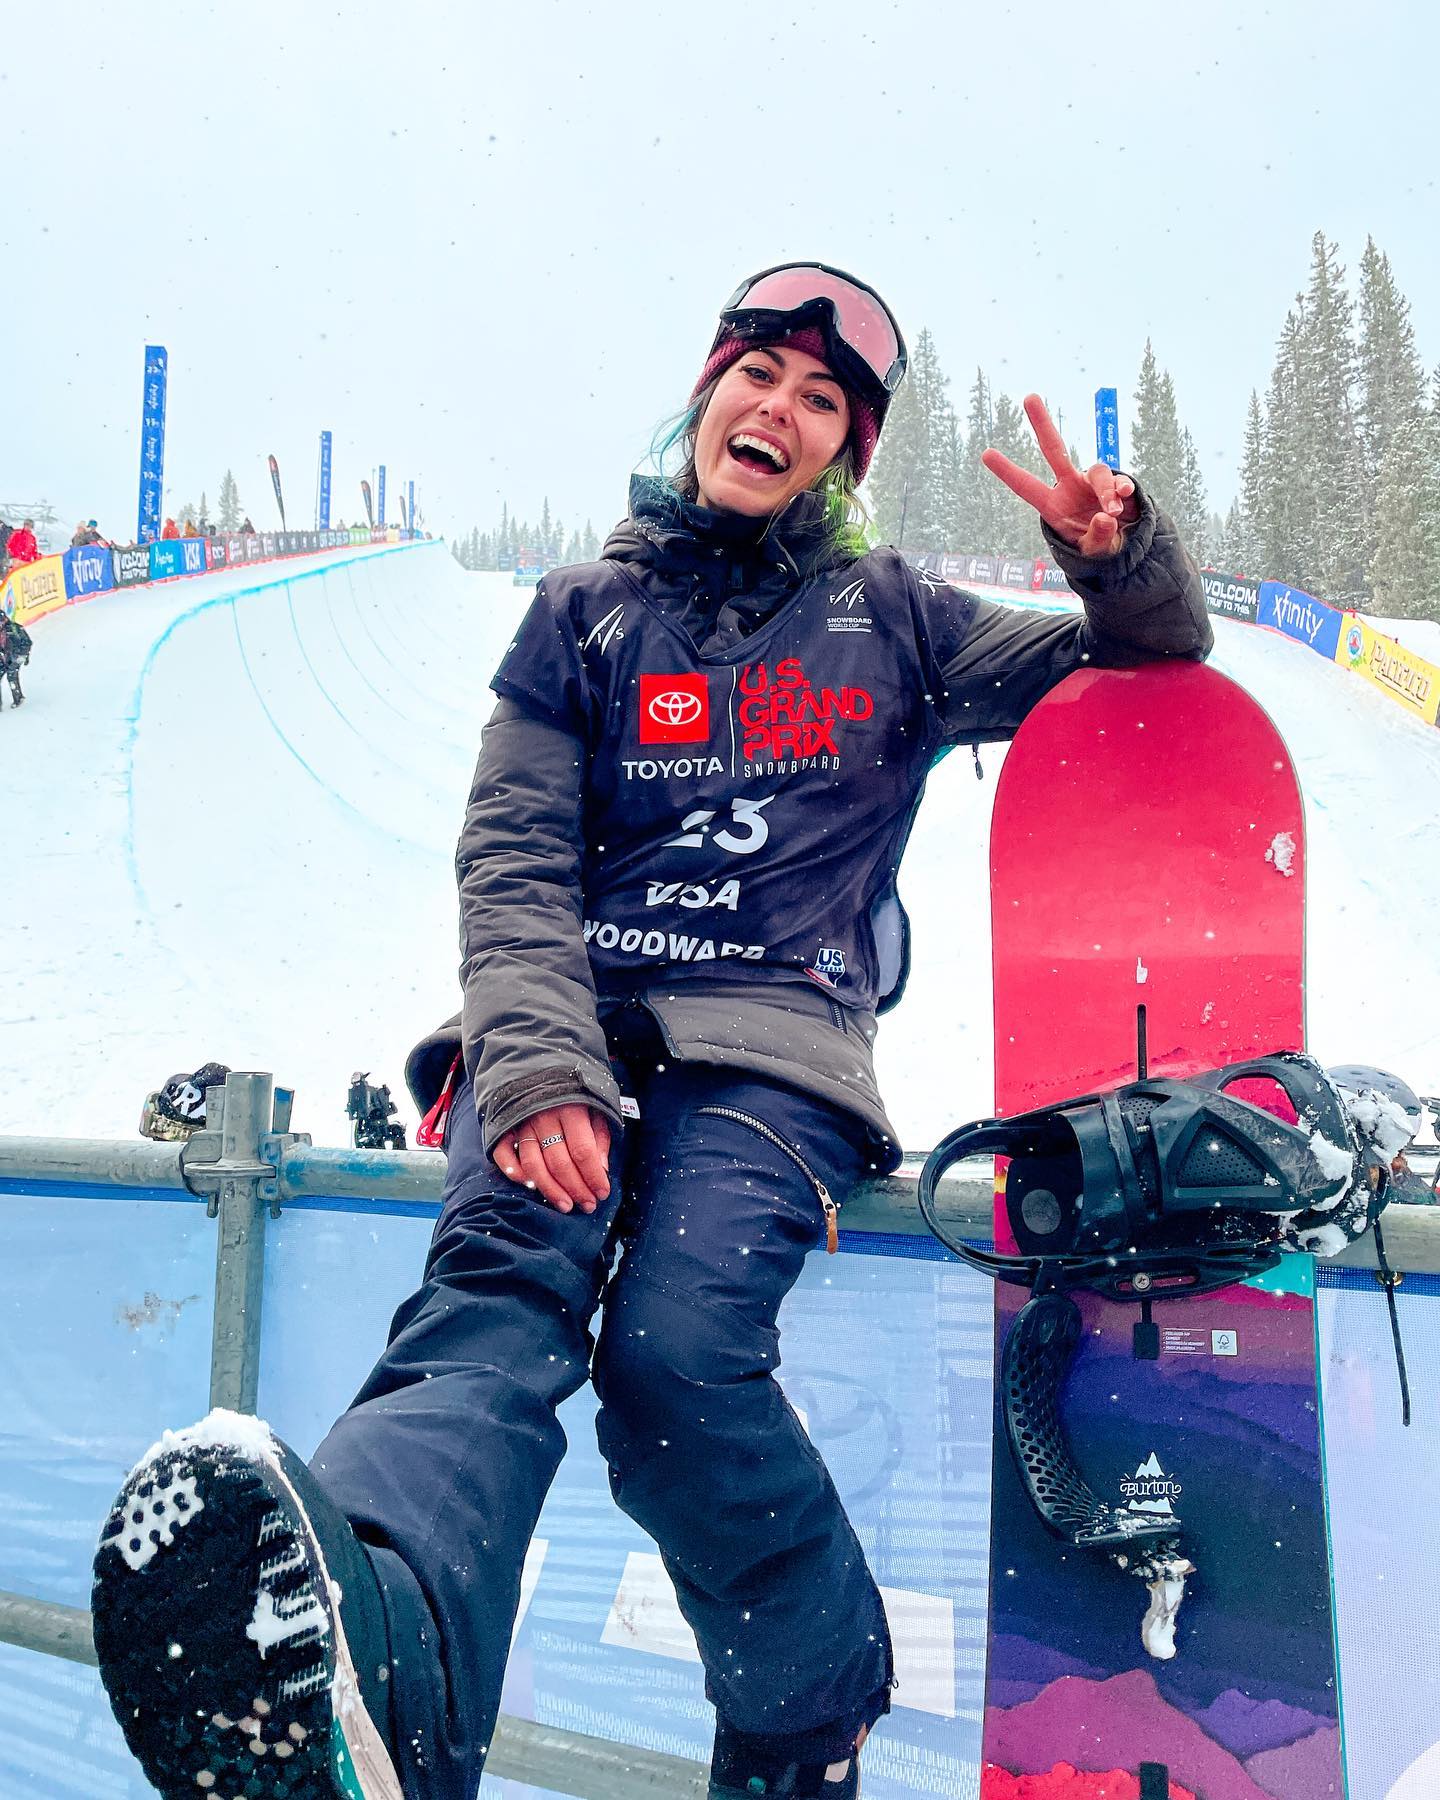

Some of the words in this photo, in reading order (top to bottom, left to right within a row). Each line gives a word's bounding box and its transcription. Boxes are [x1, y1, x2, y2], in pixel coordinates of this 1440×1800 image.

[1204, 577, 1257, 606] VOLCOM
[1223, 601, 1232, 611] TO
[1272, 590, 1324, 644] xfinity
[826, 617, 873, 625] SNOWBOARD
[739, 657, 811, 697] U.S.
[738, 686, 875, 729] GRAND
[743, 718, 841, 762] PRIX
[621, 756, 725, 781] TOYOTA
[743, 755, 841, 779] SNOWBOARD
[645, 879, 741, 912] VSA
[818, 950, 843, 967] US
[1119, 1479, 1182, 1497] Burton
